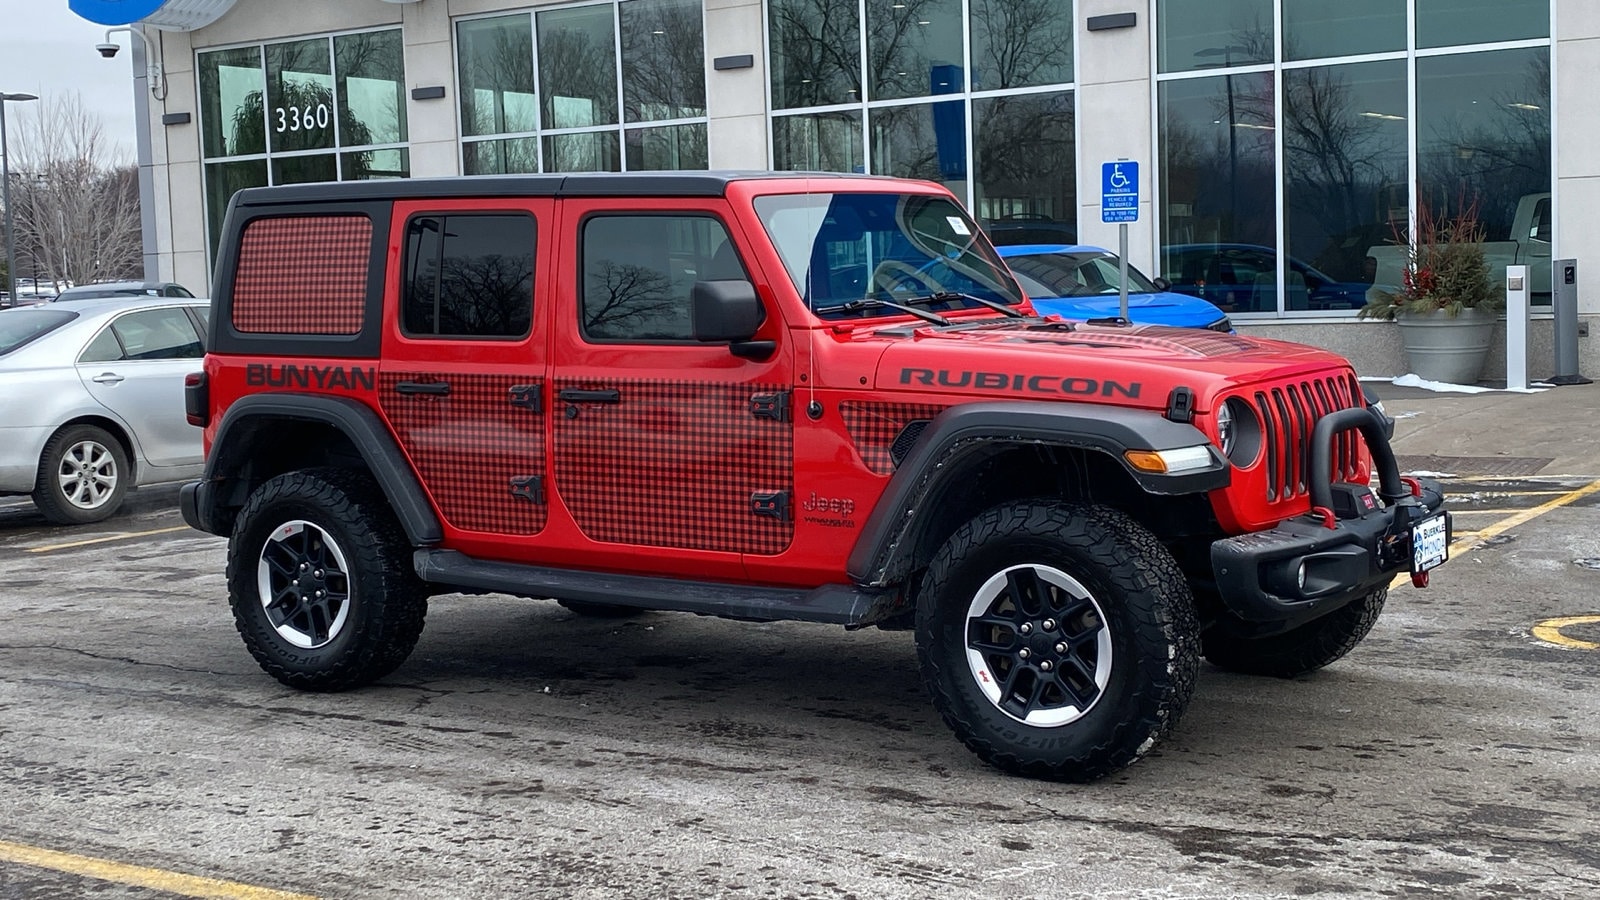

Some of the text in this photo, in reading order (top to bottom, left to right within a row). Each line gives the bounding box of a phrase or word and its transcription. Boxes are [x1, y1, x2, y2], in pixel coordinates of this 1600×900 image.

[276, 103, 328, 132] 3360
[246, 363, 375, 391] BUNYAN
[899, 367, 1141, 399] RUBICON
[802, 491, 854, 518] Jeep
